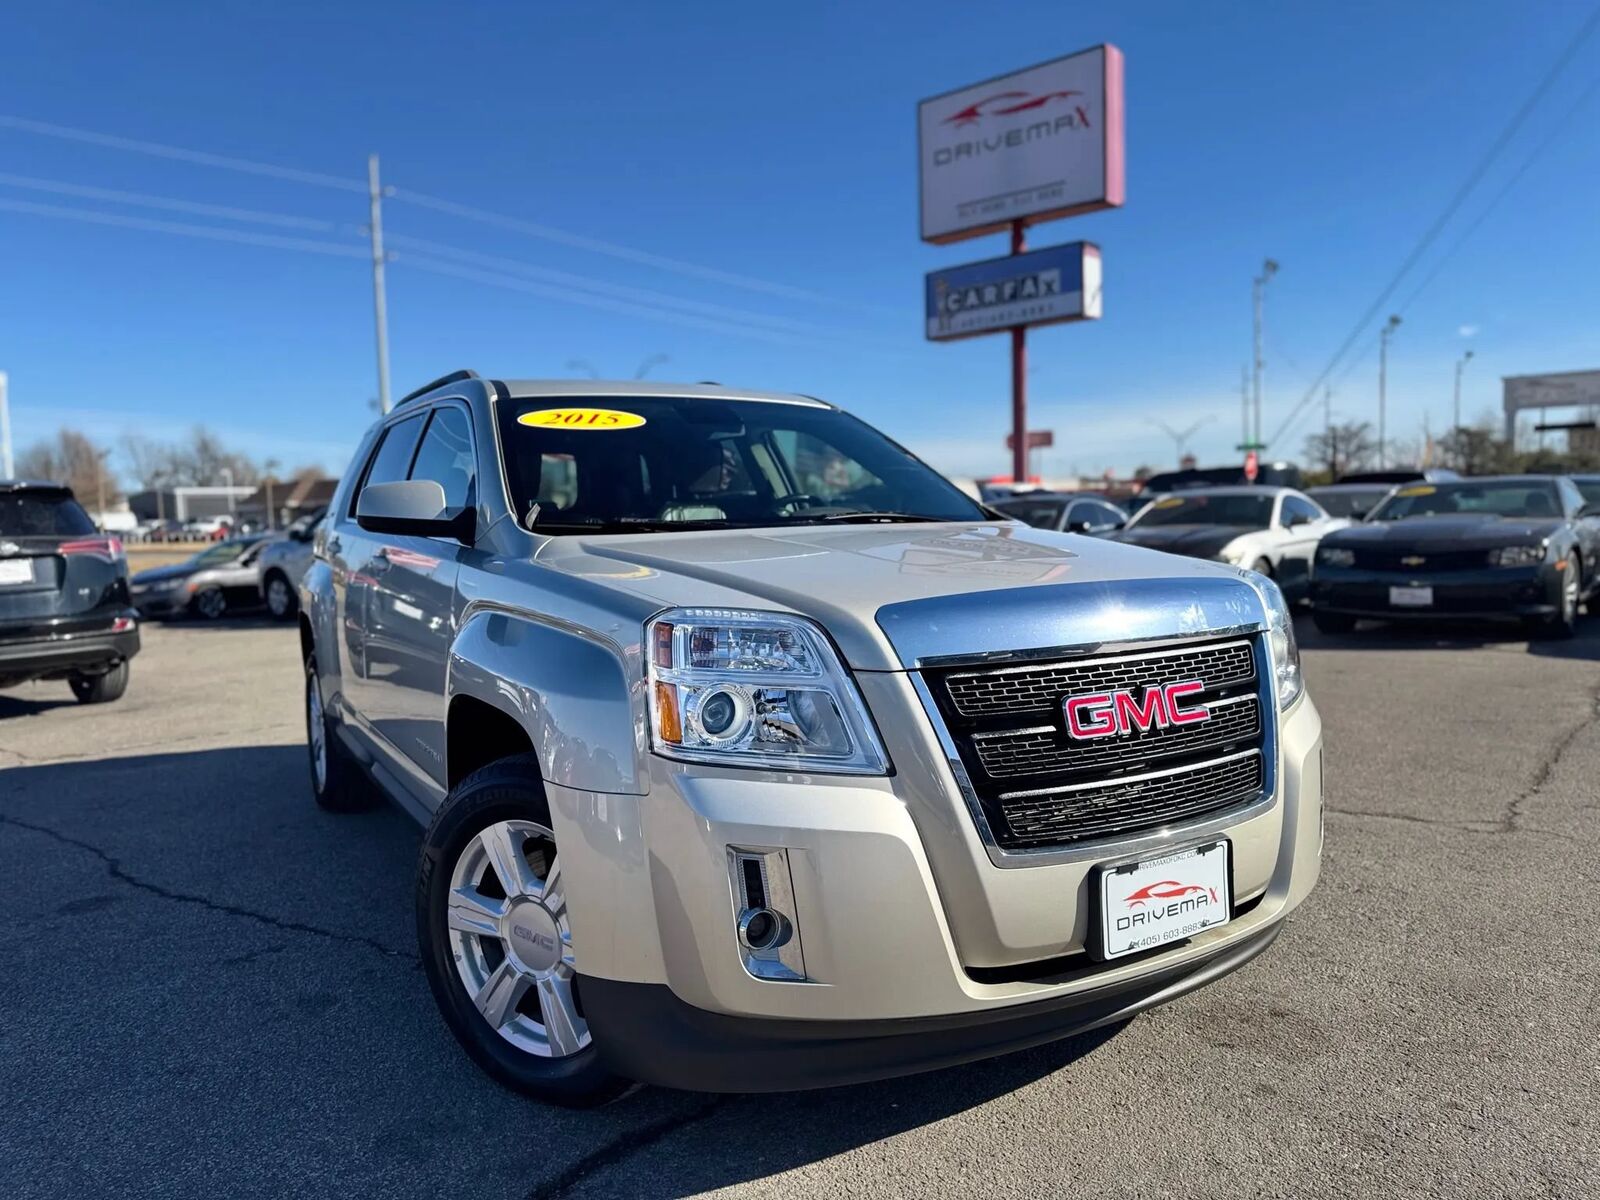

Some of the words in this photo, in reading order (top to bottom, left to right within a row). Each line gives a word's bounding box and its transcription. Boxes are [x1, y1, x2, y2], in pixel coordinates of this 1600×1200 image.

[933, 104, 1090, 168] DRIVEMAX
[946, 271, 1060, 312] CARFAX
[542, 412, 623, 425] 2015
[1062, 679, 1211, 740] GMC
[1116, 887, 1218, 931] DRIVEMAX
[514, 925, 554, 952] GMC
